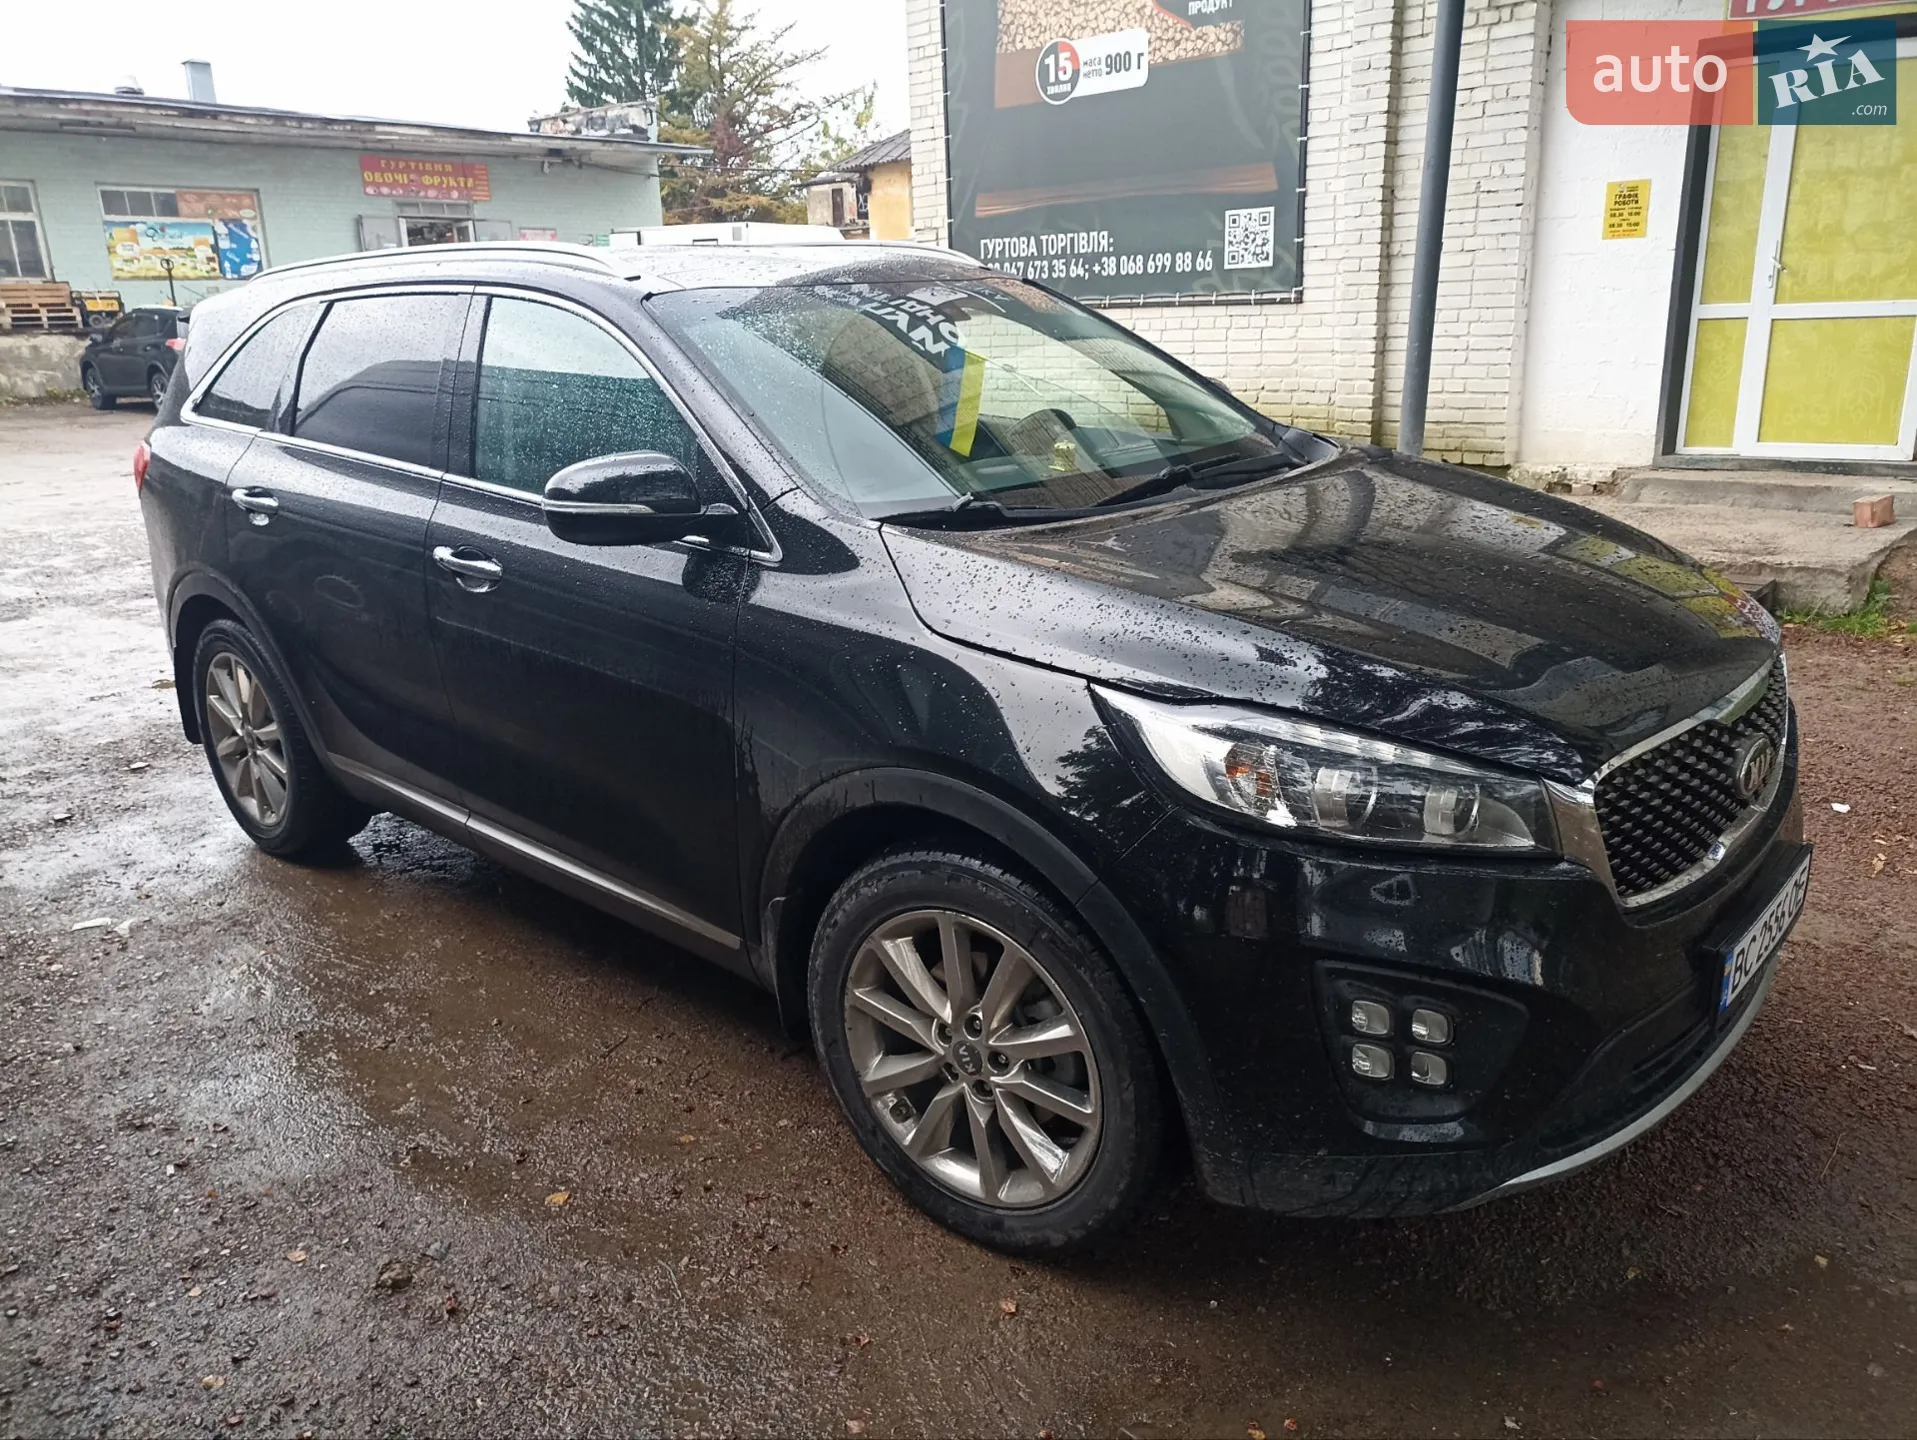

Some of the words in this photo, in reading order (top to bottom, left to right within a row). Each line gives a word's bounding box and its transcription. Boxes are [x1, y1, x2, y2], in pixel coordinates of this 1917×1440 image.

[1044, 51, 1073, 83] 15
[1083, 56, 1101, 67] маса
[1105, 50, 1132, 75] 900
[363, 171, 409, 184] ОВОЧІ
[980, 236, 1038, 259] ГУРТОВА
[1040, 231, 1114, 257] ТОРГІВЛЯ:
[1027, 260, 1049, 280] 673
[1051, 258, 1066, 279] 35
[1069, 257, 1089, 280] 64;
[1092, 255, 1117, 276] +38
[1119, 254, 1144, 275] 068
[1147, 252, 1172, 274] 699
[1175, 251, 1192, 273] 88
[1196, 250, 1213, 272] 66
[1731, 934, 1757, 994] BC
[958, 1045, 976, 1073] KIA
